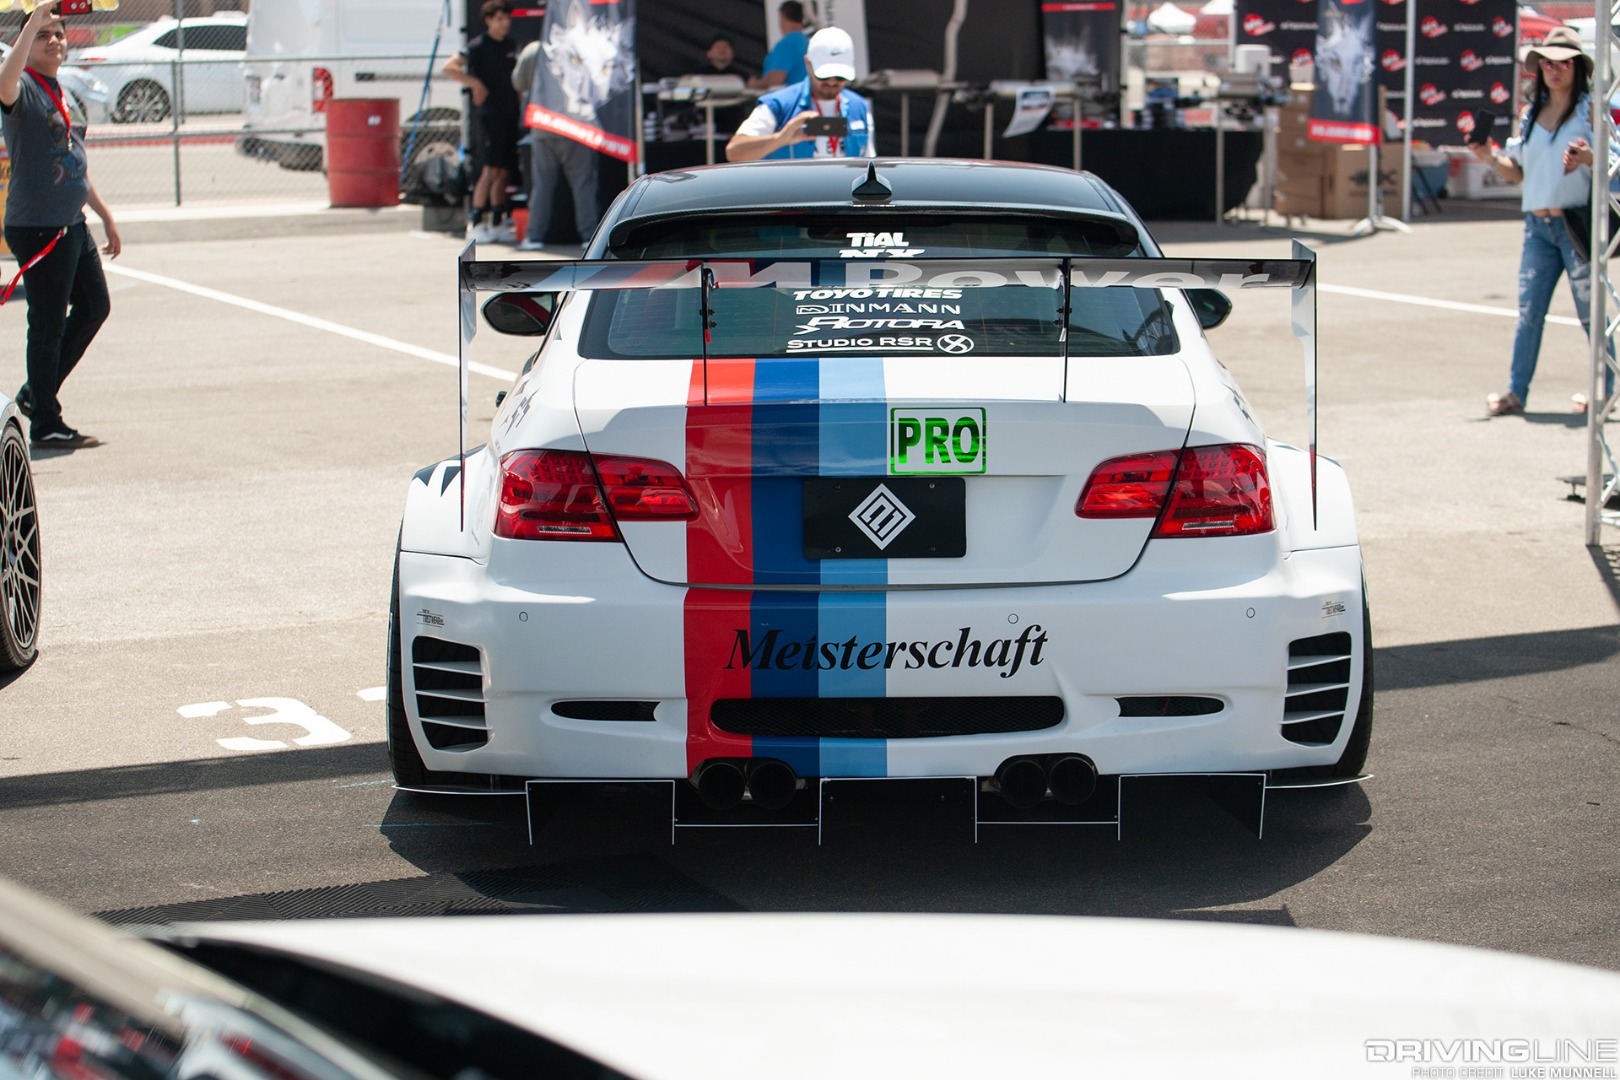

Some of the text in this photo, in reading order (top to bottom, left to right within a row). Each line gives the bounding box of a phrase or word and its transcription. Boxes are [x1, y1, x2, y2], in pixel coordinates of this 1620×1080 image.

[793, 288, 963, 301] TOYO TIRES
[796, 303, 961, 315] DINMANN
[787, 336, 933, 349] STUDIO RSR
[897, 416, 980, 464] PRO
[722, 624, 1048, 679] Meisterschaft
